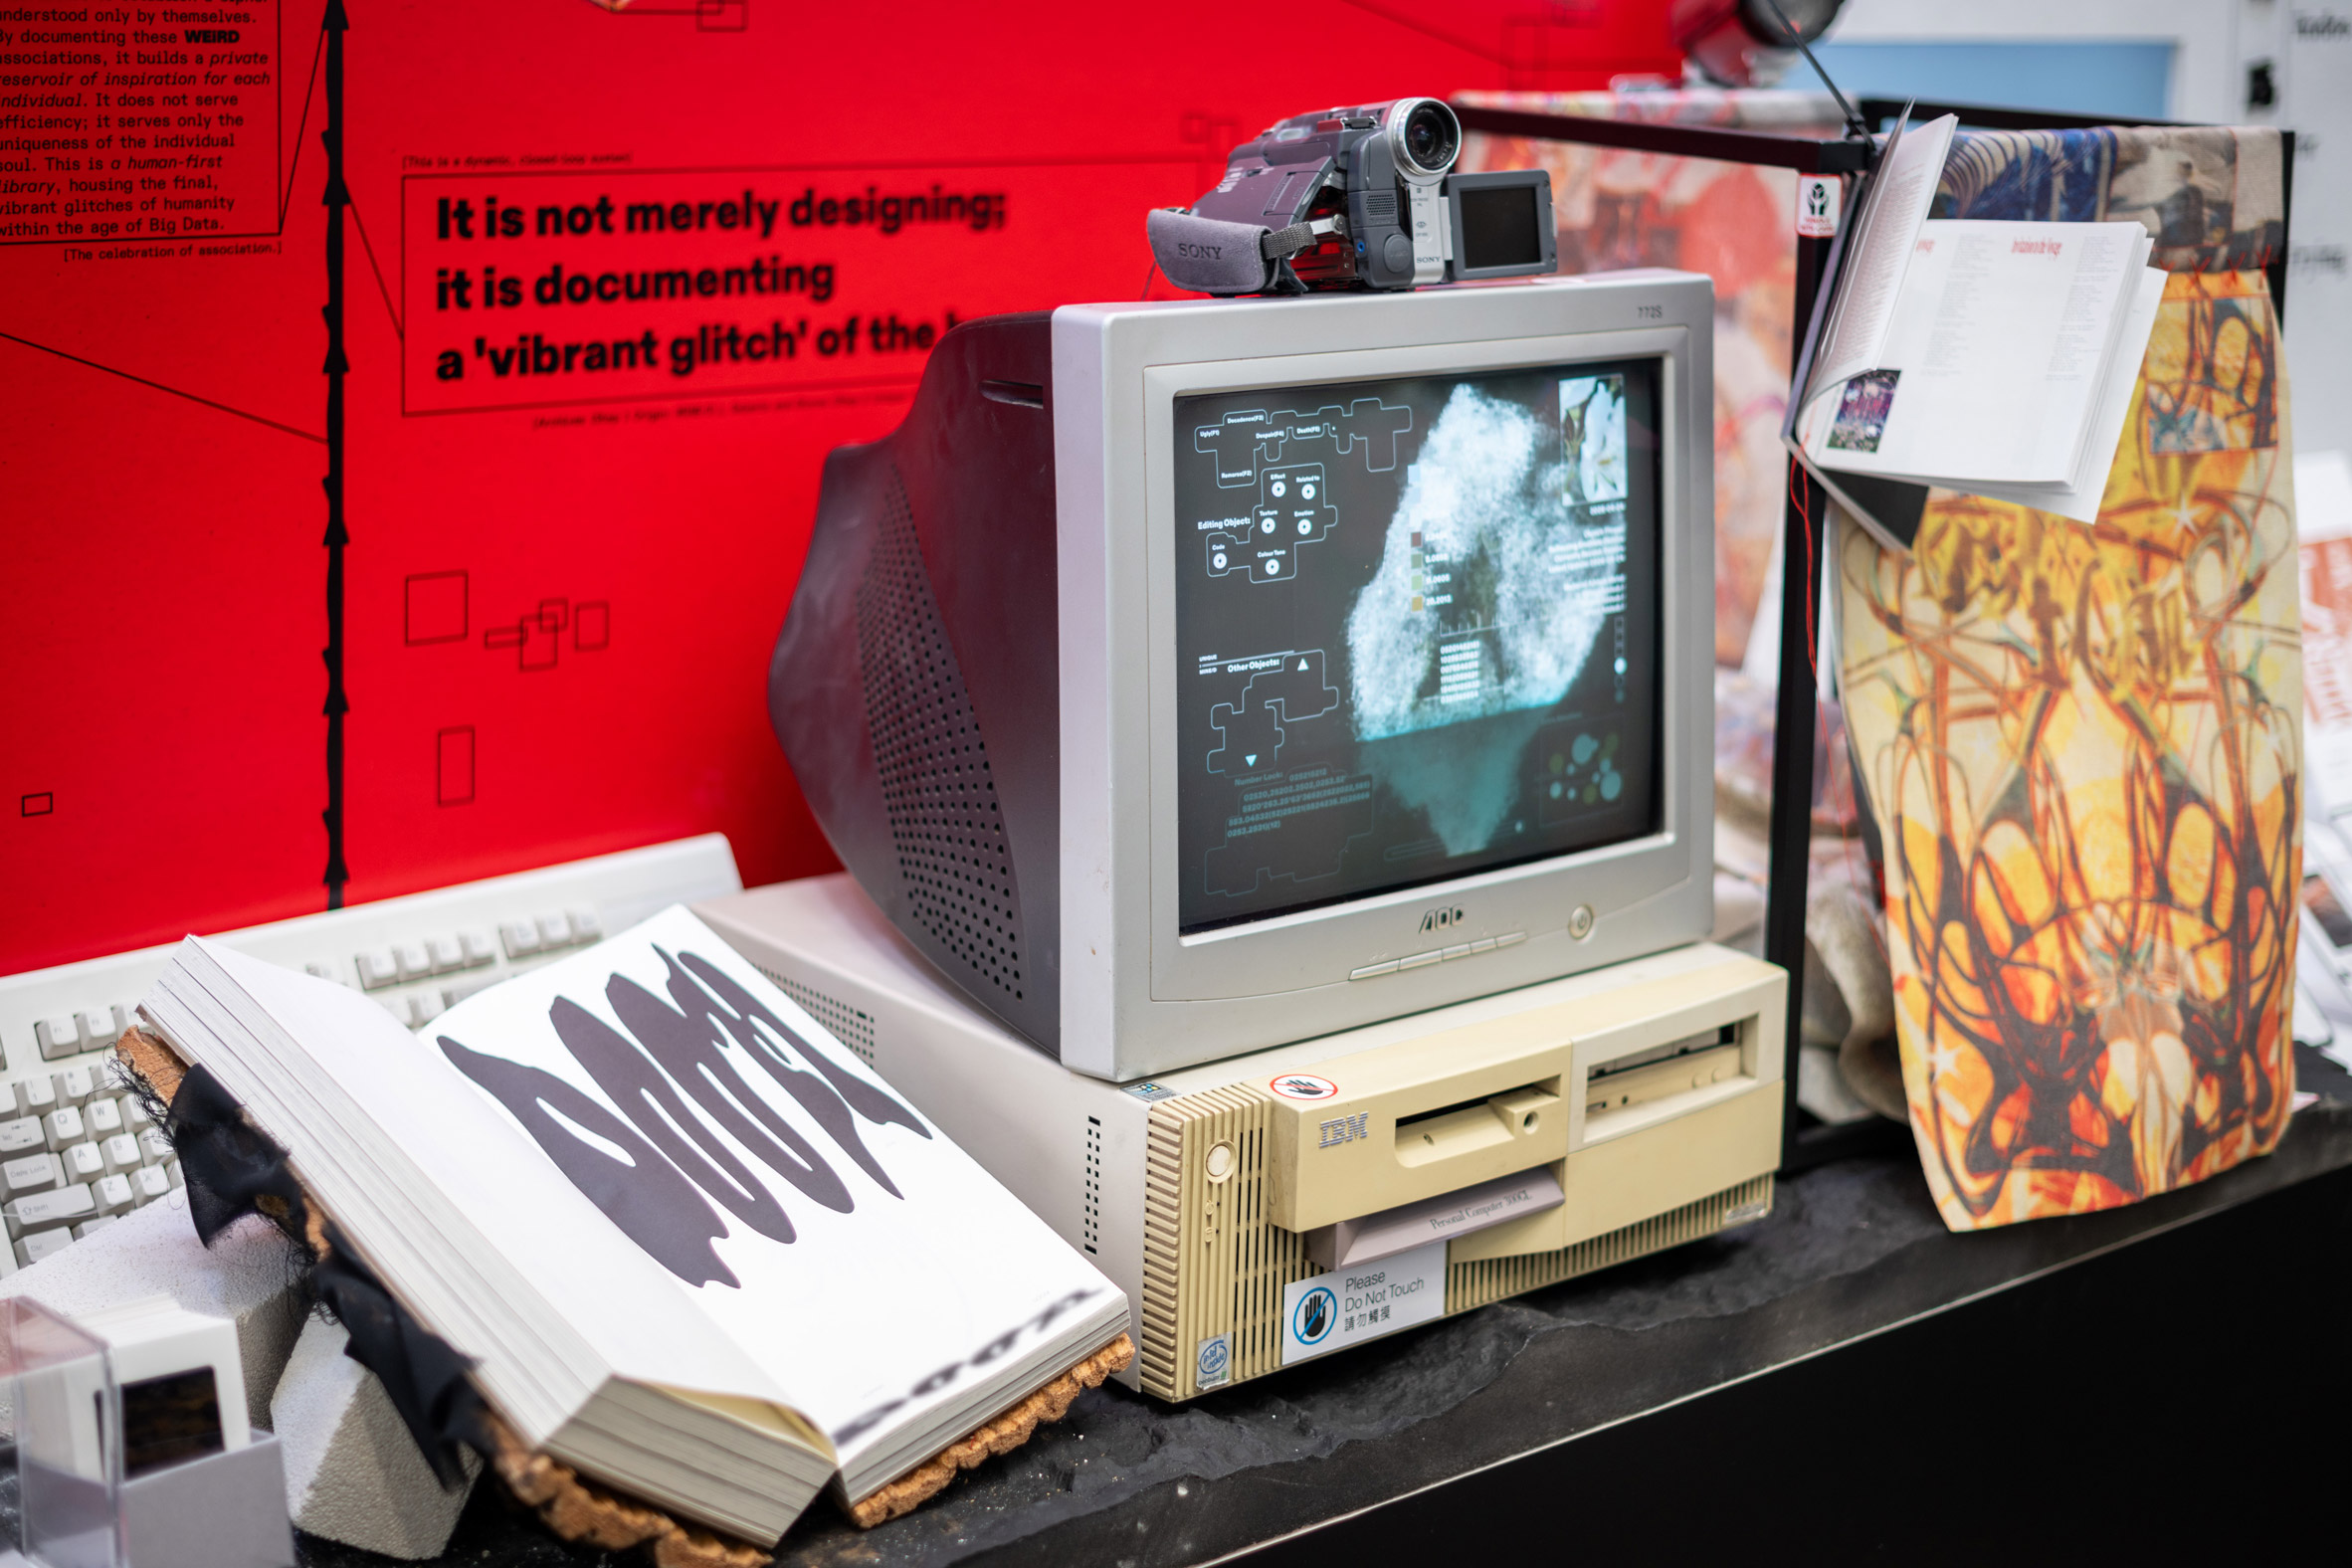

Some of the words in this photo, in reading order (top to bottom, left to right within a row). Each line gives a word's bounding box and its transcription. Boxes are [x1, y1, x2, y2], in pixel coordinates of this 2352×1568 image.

[95, 8, 130, 26] only
[137, 9, 156, 26] by
[162, 9, 257, 23] themselves.
[21, 29, 126, 47] documenting
[133, 29, 178, 44] these
[0, 51, 107, 67] ssociations,
[116, 51, 130, 65] it
[137, 51, 188, 65] builds
[195, 54, 204, 65] a
[209, 51, 269, 68] private
[0, 72, 75, 87] eservoir
[80, 72, 98, 86] of
[103, 71, 197, 89] inspiration
[203, 71, 228, 86] for
[234, 71, 271, 86] each
[0, 93, 88, 107] ndividual.
[96, 93, 111, 106] It
[117, 93, 154, 106] does
[162, 94, 188, 106] not
[195, 96, 239, 106] serve
[97, 114, 110, 128] it
[117, 115, 170, 127] serves
[177, 113, 212, 131] only
[218, 112, 244, 126] the
[0, 137, 89, 153] niqueness
[96, 135, 112, 149] of
[119, 135, 146, 148] the
[153, 133, 235, 148] individual
[45, 157, 81, 171] This
[88, 157, 103, 170] is
[110, 159, 120, 170] a
[127, 154, 223, 170] human-first
[0, 179, 60, 196] ibrary,
[69, 177, 133, 194] housing
[139, 176, 166, 190] the
[173, 174, 218, 190] final,
[65, 199, 133, 217] glitches
[140, 197, 157, 213] of
[164, 196, 235, 213] humanity
[438, 197, 475, 240] It
[486, 196, 525, 239] is
[536, 196, 614, 236] not
[627, 187, 778, 239] merely
[790, 185, 1006, 234] designing;
[56, 221, 84, 235] the
[91, 223, 118, 237] age
[125, 218, 142, 232] of
[150, 217, 176, 234] Big
[183, 216, 225, 231] Data.
[64, 249, 93, 262] [The
[98, 246, 174, 260] celebration
[180, 244, 193, 256] of
[1178, 244, 1222, 260] SONY
[436, 269, 473, 310] it
[484, 267, 524, 307] is
[534, 256, 835, 305] documenting
[436, 349, 464, 381] a
[474, 330, 658, 378] 'vibrant
[670, 319, 808, 377] glitch'
[816, 317, 860, 355] of
[870, 315, 935, 351] the
[1197, 519, 1224, 530] Editing
[1227, 663, 1249, 674] Other
[1249, 659, 1280, 671] Objects:
[1234, 775, 1263, 786] Number
[1418, 903, 1465, 934] AOC
[57, 1113, 68, 1125] Q
[95, 1105, 105, 1117] W
[1319, 1111, 1369, 1148] IBM
[78, 1147, 87, 1159] A
[142, 1171, 152, 1183] X
[105, 1181, 114, 1192] Z
[1430, 1208, 1466, 1230] Personal
[1465, 1201, 1503, 1219] Computer
[1345, 1272, 1386, 1293] Please
[1345, 1296, 1363, 1312] Do
[1365, 1287, 1386, 1306] Not
[1389, 1276, 1425, 1298] Touch
